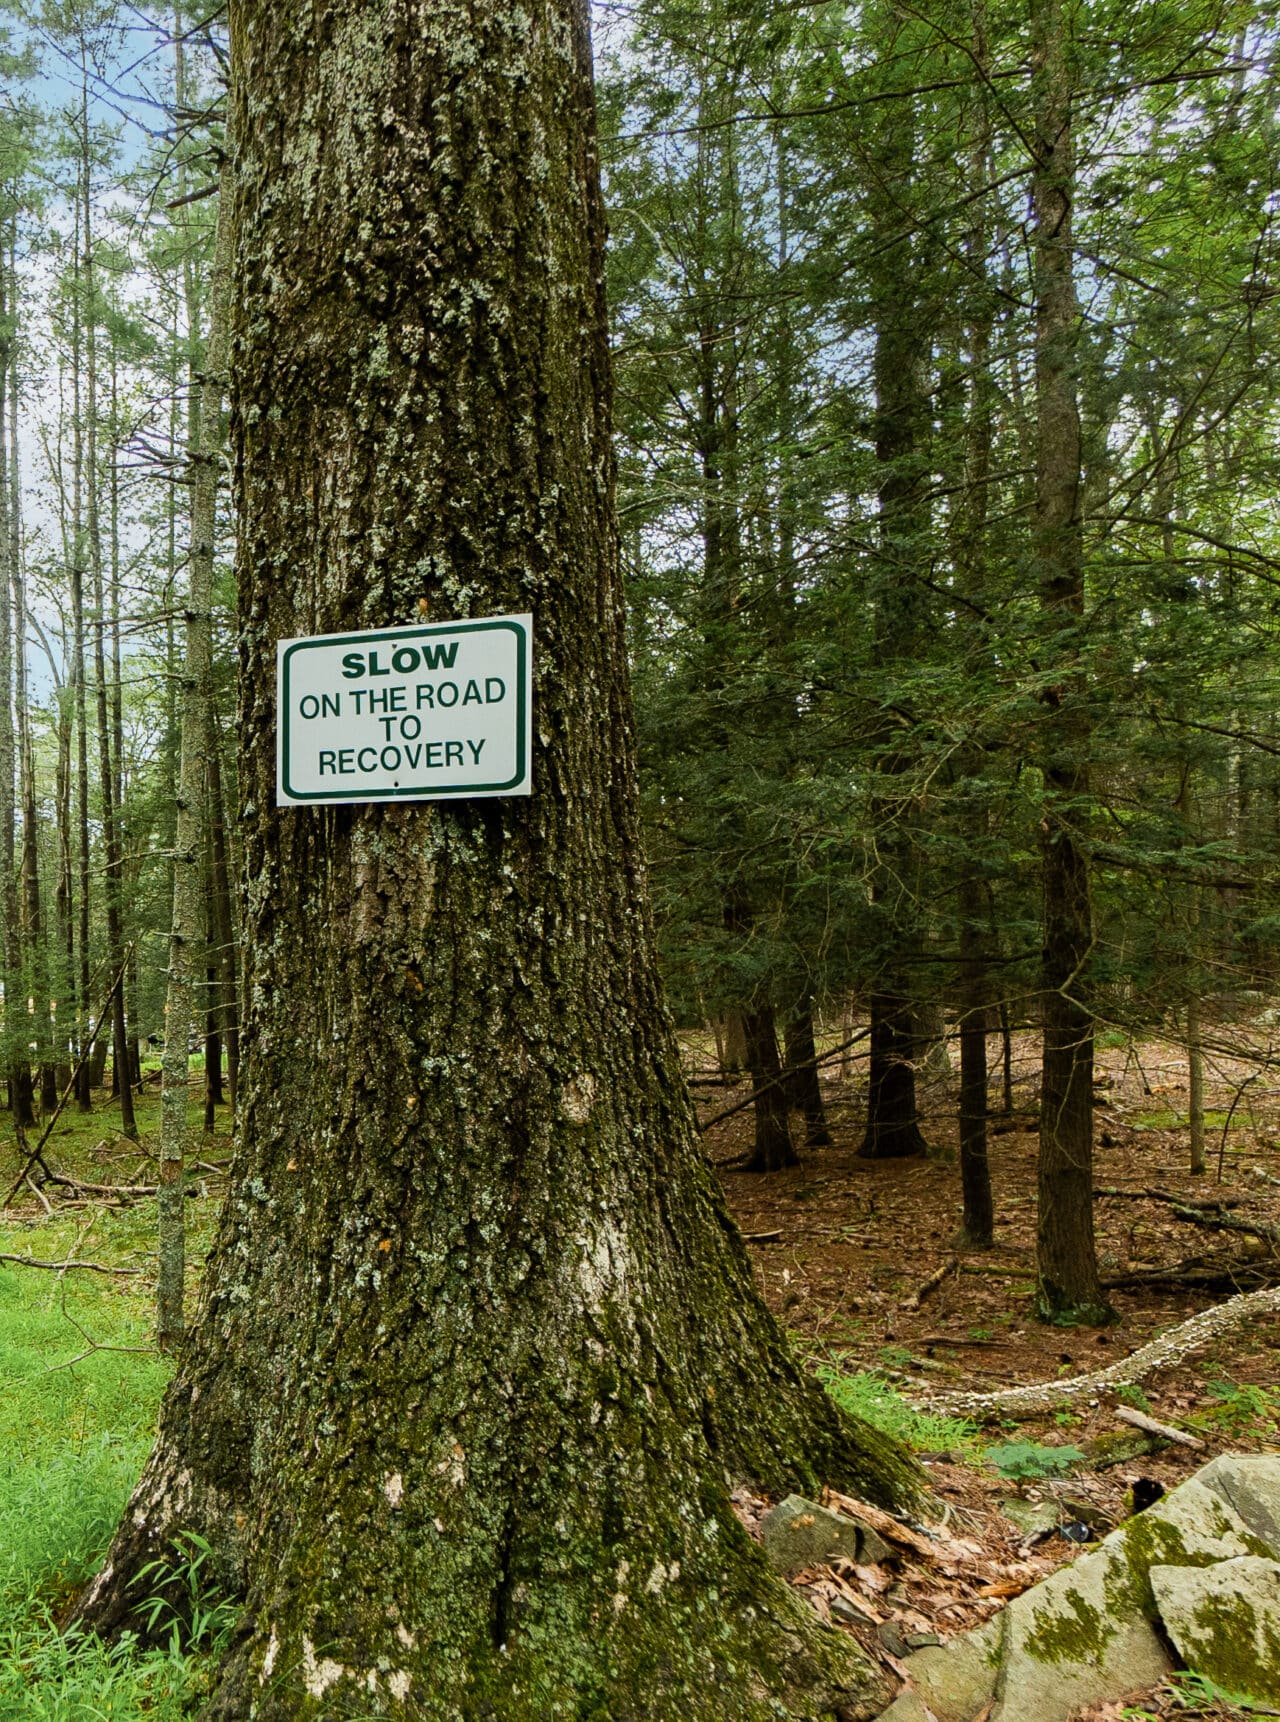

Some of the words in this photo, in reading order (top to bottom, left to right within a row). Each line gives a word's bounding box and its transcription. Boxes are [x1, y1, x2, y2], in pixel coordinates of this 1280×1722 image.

[341, 642, 460, 679] SLOW
[299, 692, 341, 720] ON
[348, 686, 408, 715] THE
[415, 677, 507, 710] ROAD
[378, 714, 422, 742] TO
[319, 738, 487, 776] RECOVERY
